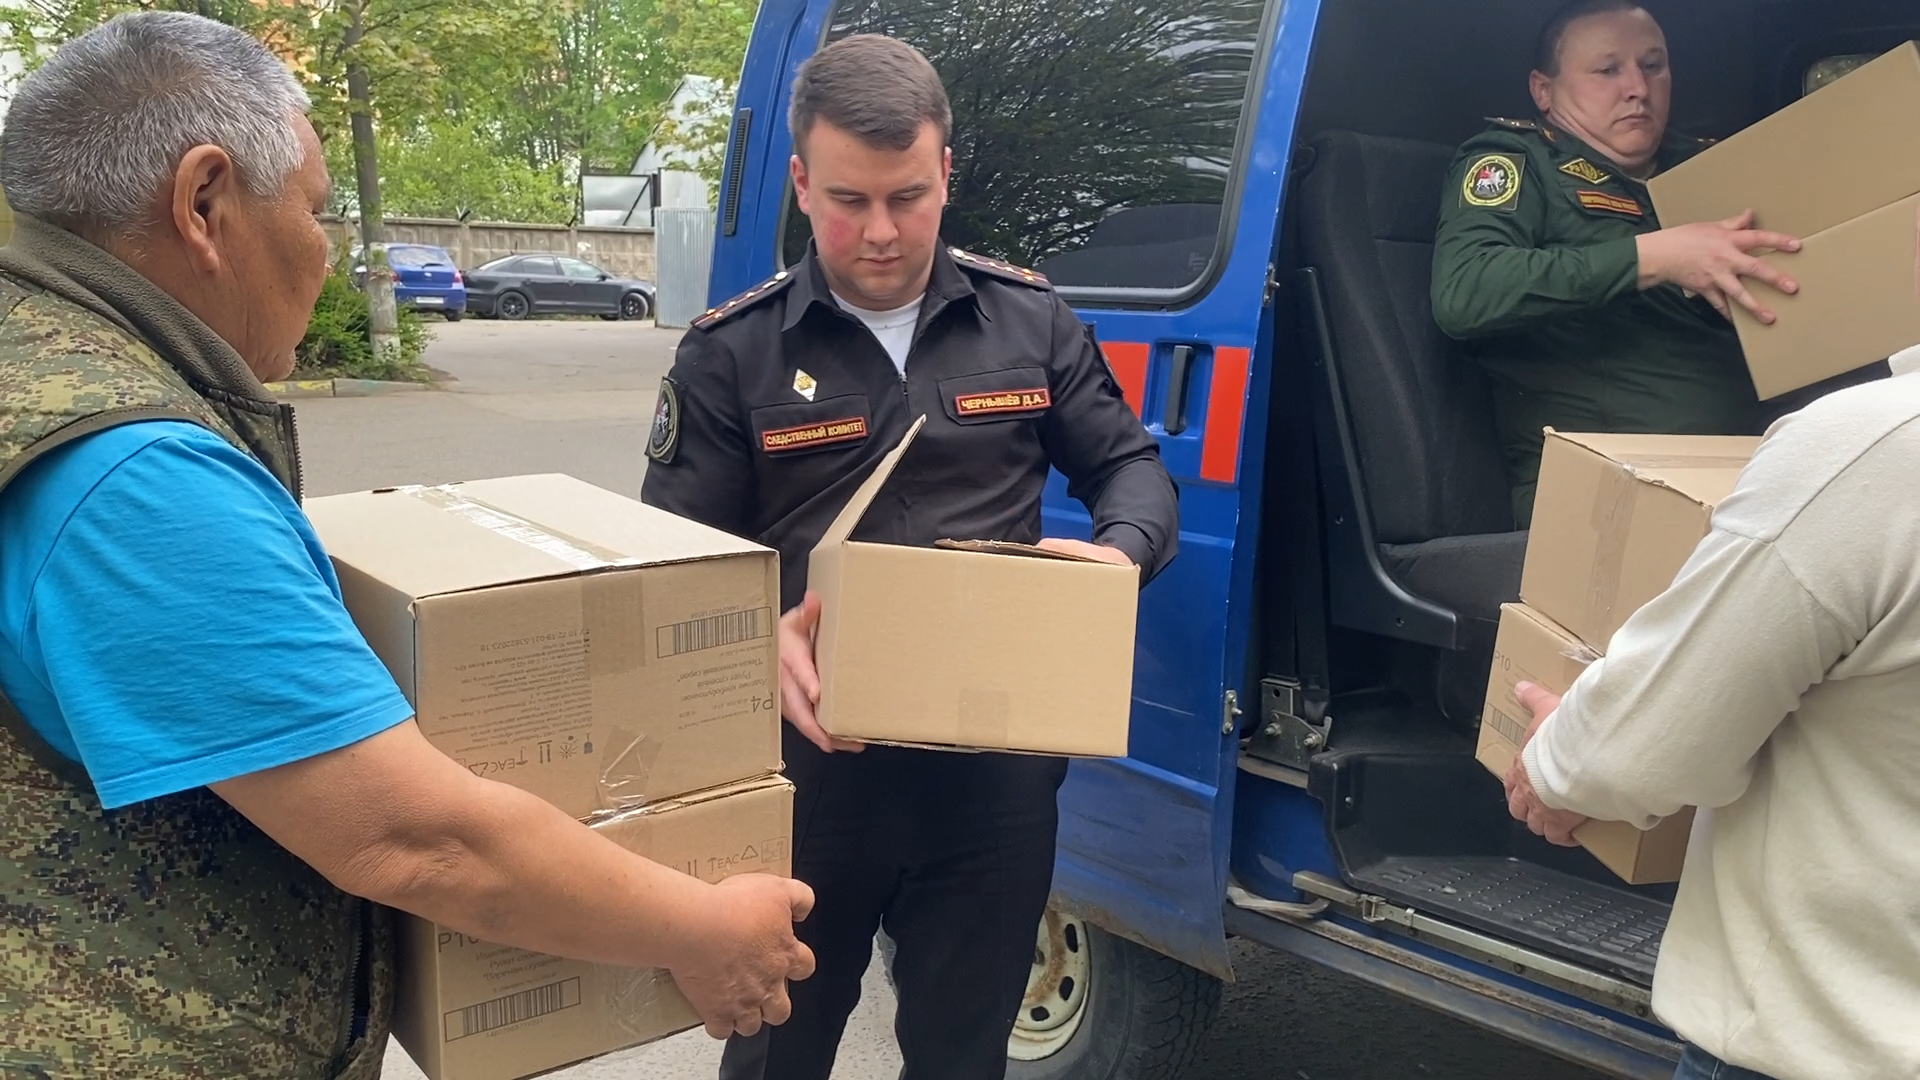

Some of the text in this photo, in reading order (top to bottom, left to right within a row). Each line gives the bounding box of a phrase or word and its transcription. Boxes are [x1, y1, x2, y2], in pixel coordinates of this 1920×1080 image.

[961, 394, 1045, 409] ЧЕРНЫШЁВ Д.А.
[766, 421, 864, 446] СЛЕДСТВЕННЫЙ КОМИТЕТ
